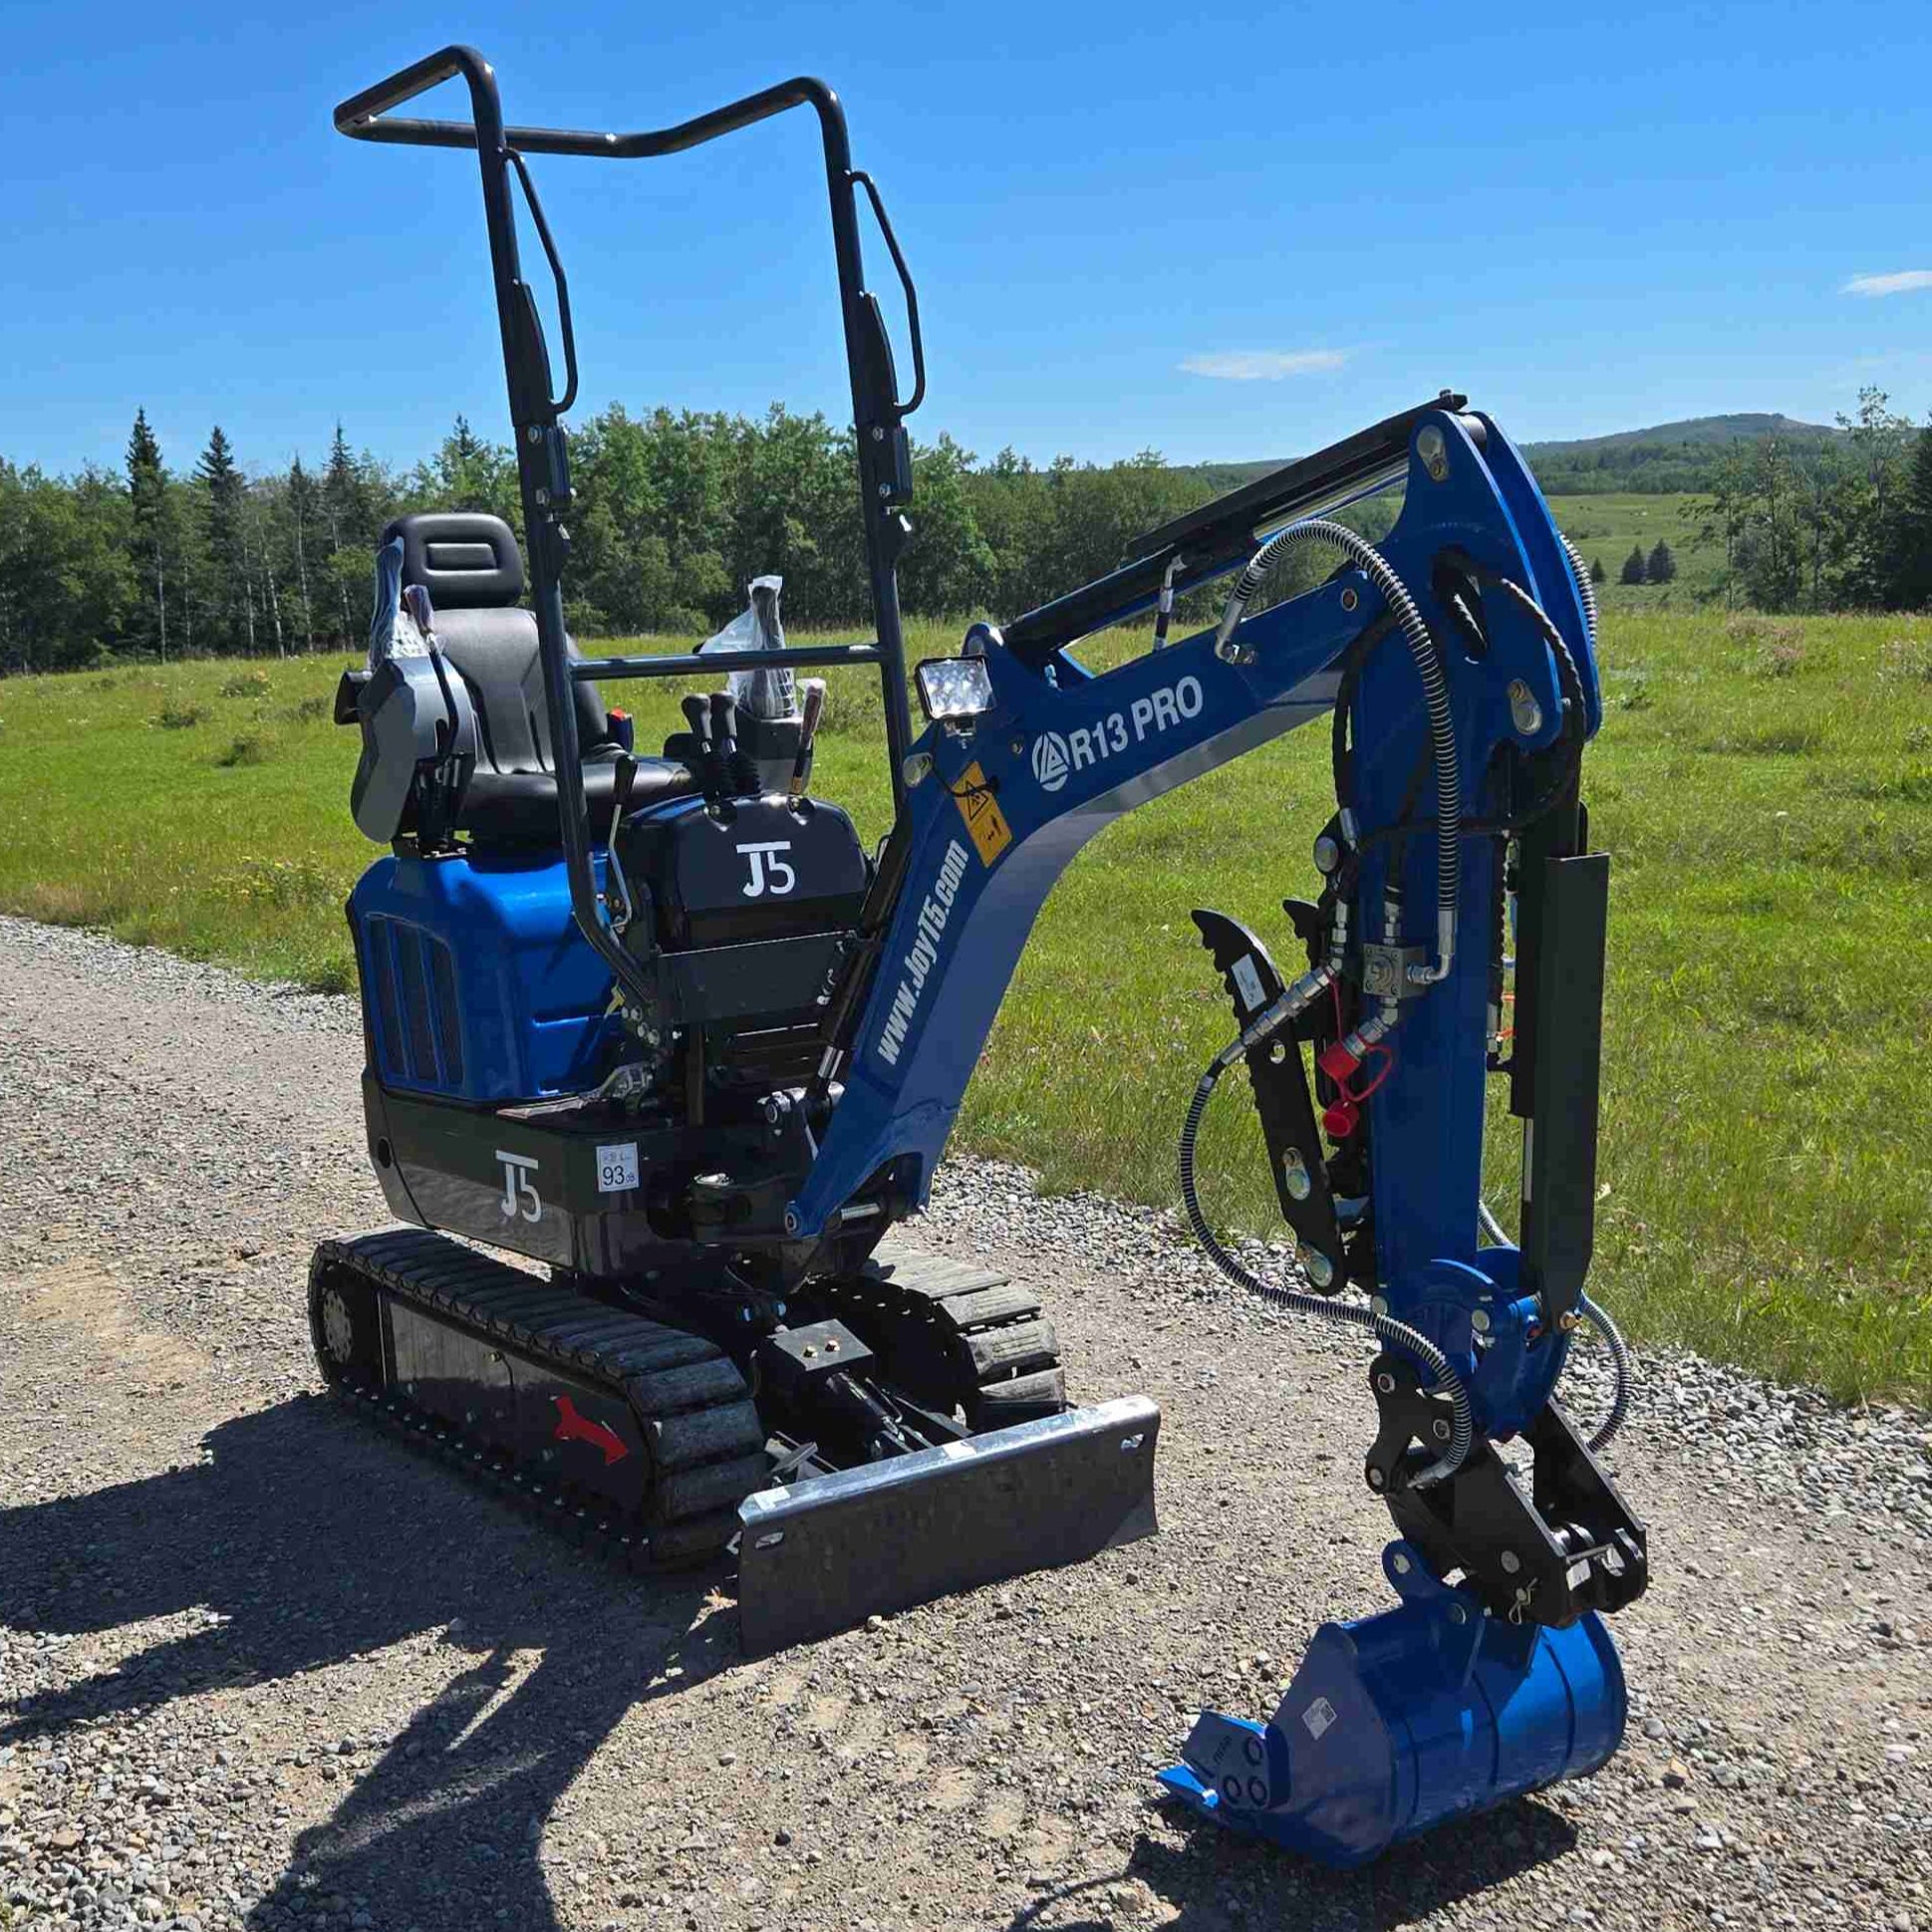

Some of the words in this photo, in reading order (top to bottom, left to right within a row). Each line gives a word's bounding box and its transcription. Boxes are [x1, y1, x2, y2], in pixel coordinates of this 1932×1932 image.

[1068, 712, 1129, 771] R13
[1130, 676, 1204, 741] PRO
[602, 1165, 625, 1186] 93
